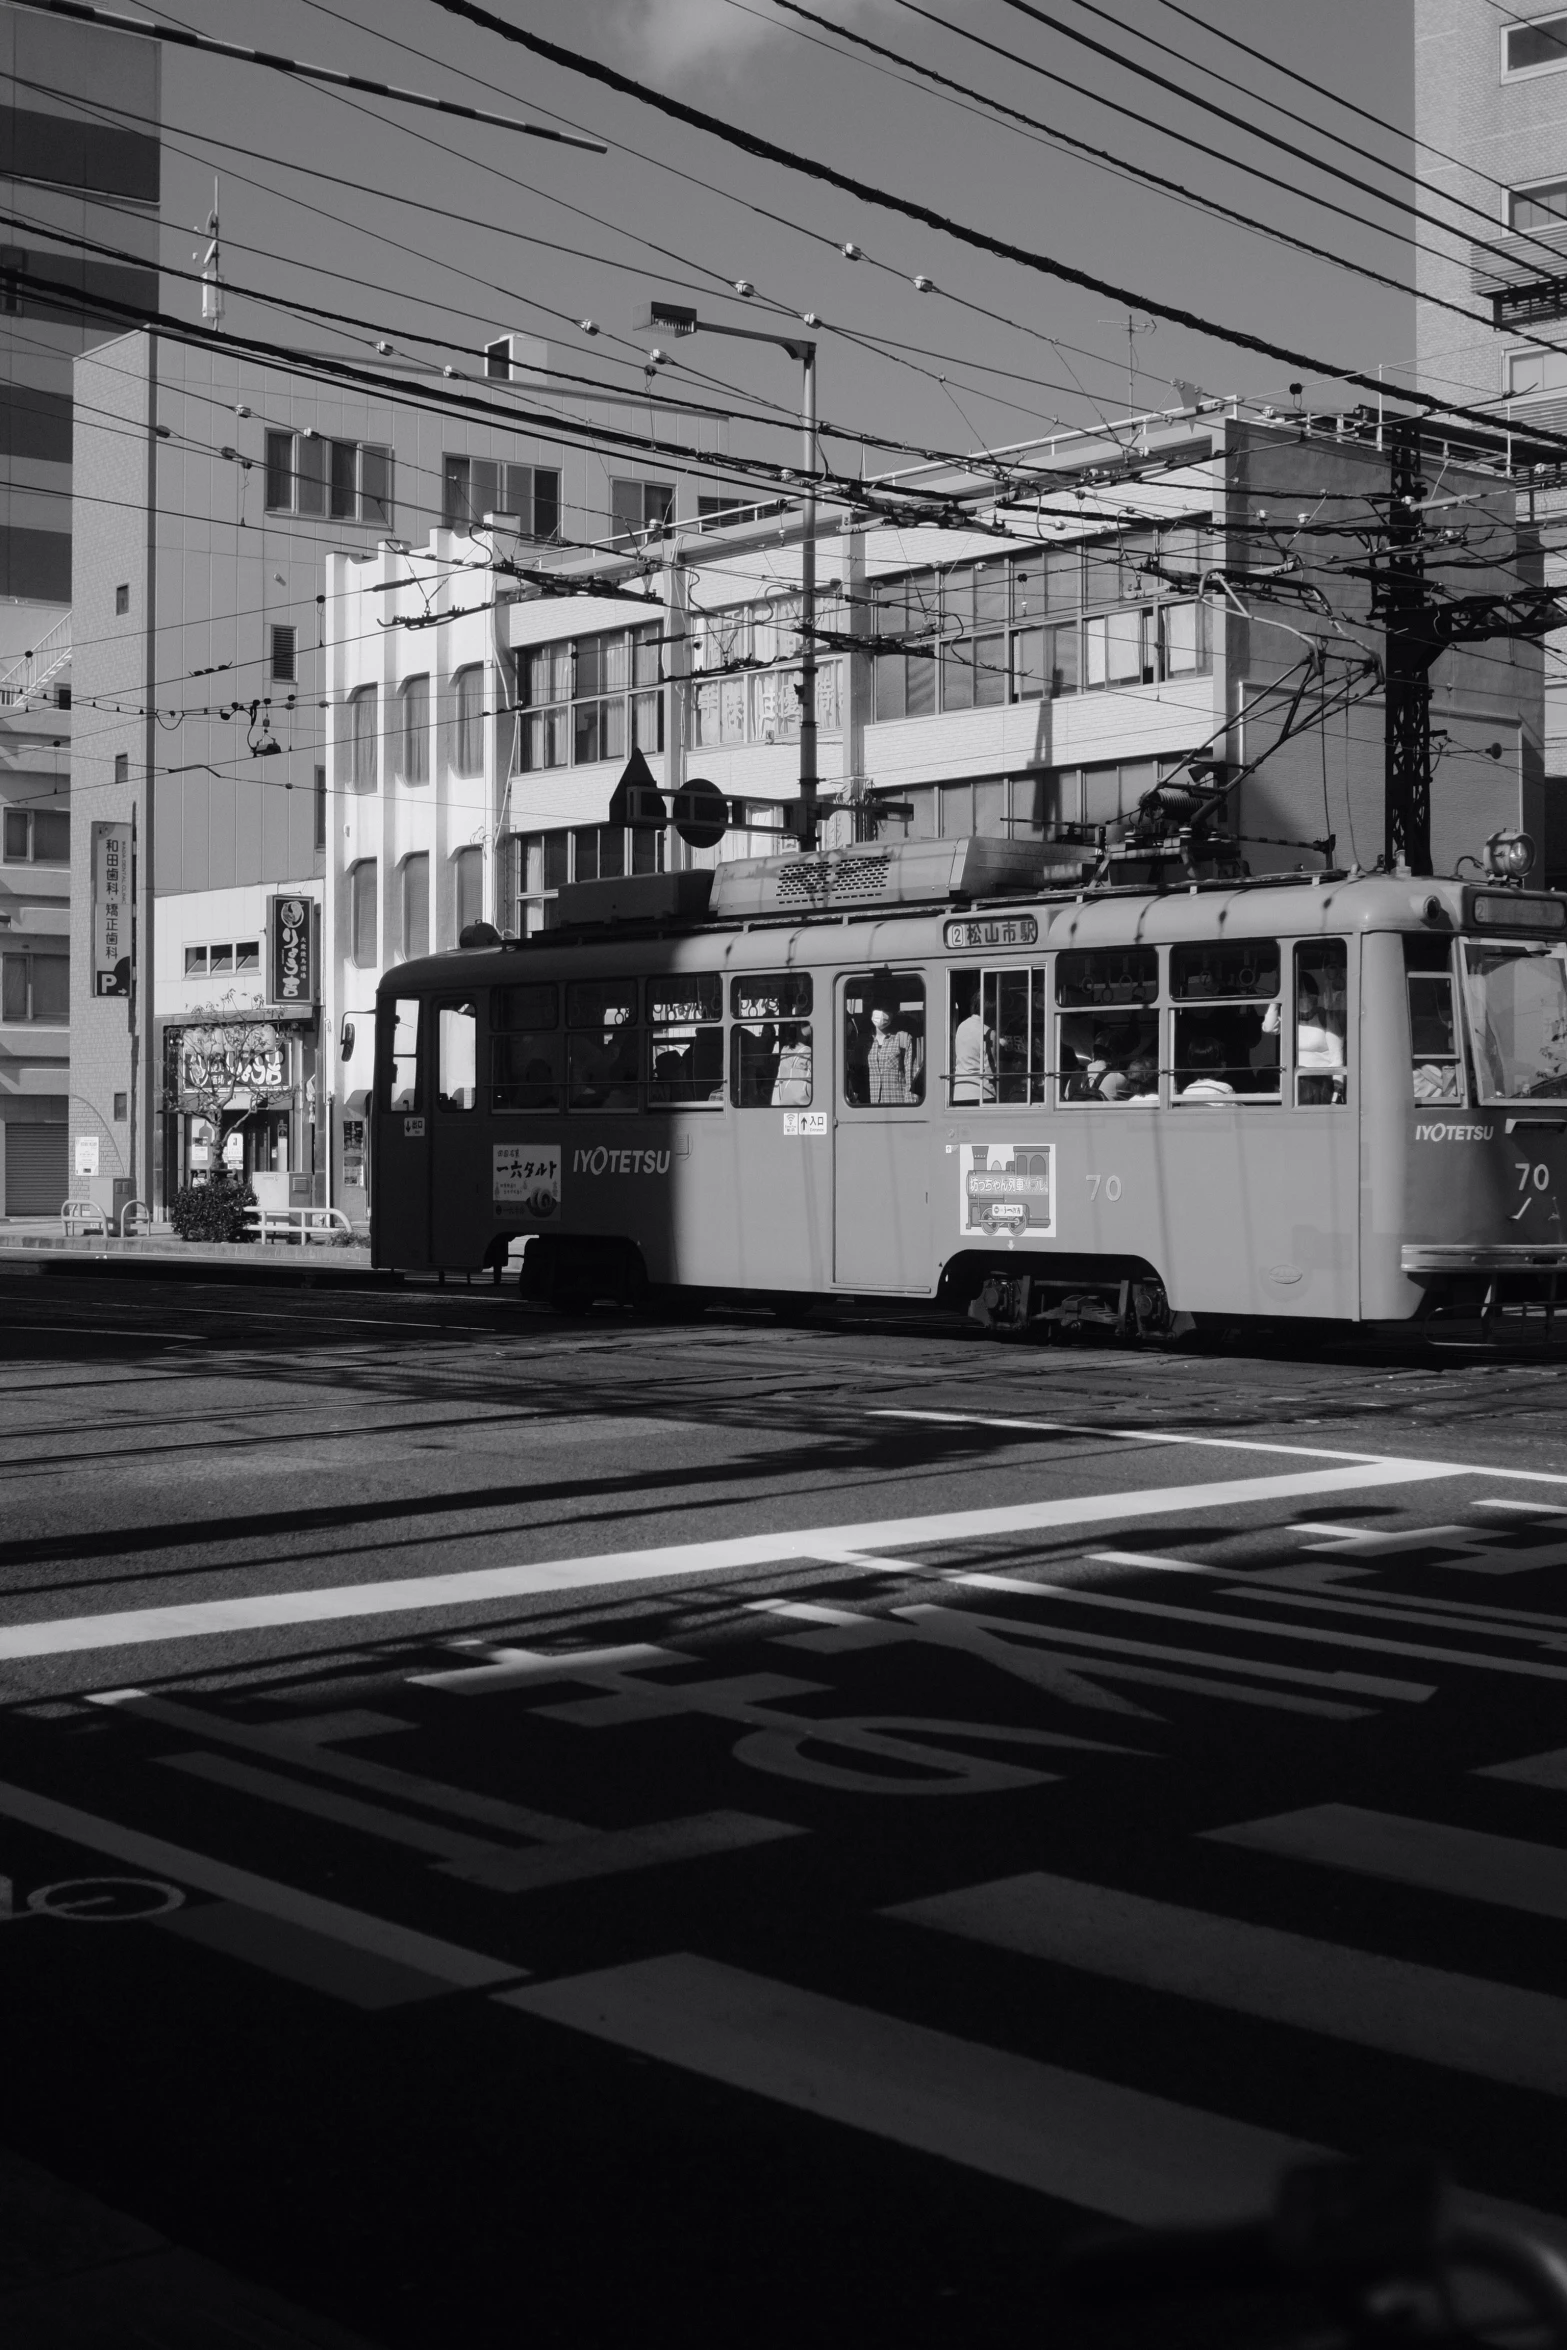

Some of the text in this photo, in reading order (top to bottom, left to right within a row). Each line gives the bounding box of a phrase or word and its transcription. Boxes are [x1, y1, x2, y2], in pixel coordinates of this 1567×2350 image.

[105, 839, 119, 960] 和田歯科・矯正歯科
[966, 921, 1035, 945] 松山市駅
[282, 927, 301, 997] りょう吉
[101, 973, 118, 994] P
[809, 1115, 824, 1126] 入口
[1415, 1122, 1494, 1142] IYOTETSU
[496, 1160, 558, 1179] 一六タルト
[573, 1145, 671, 1176] IYOTETSU
[1085, 1174, 1123, 1203] 70
[1515, 1162, 1550, 1191] 70
